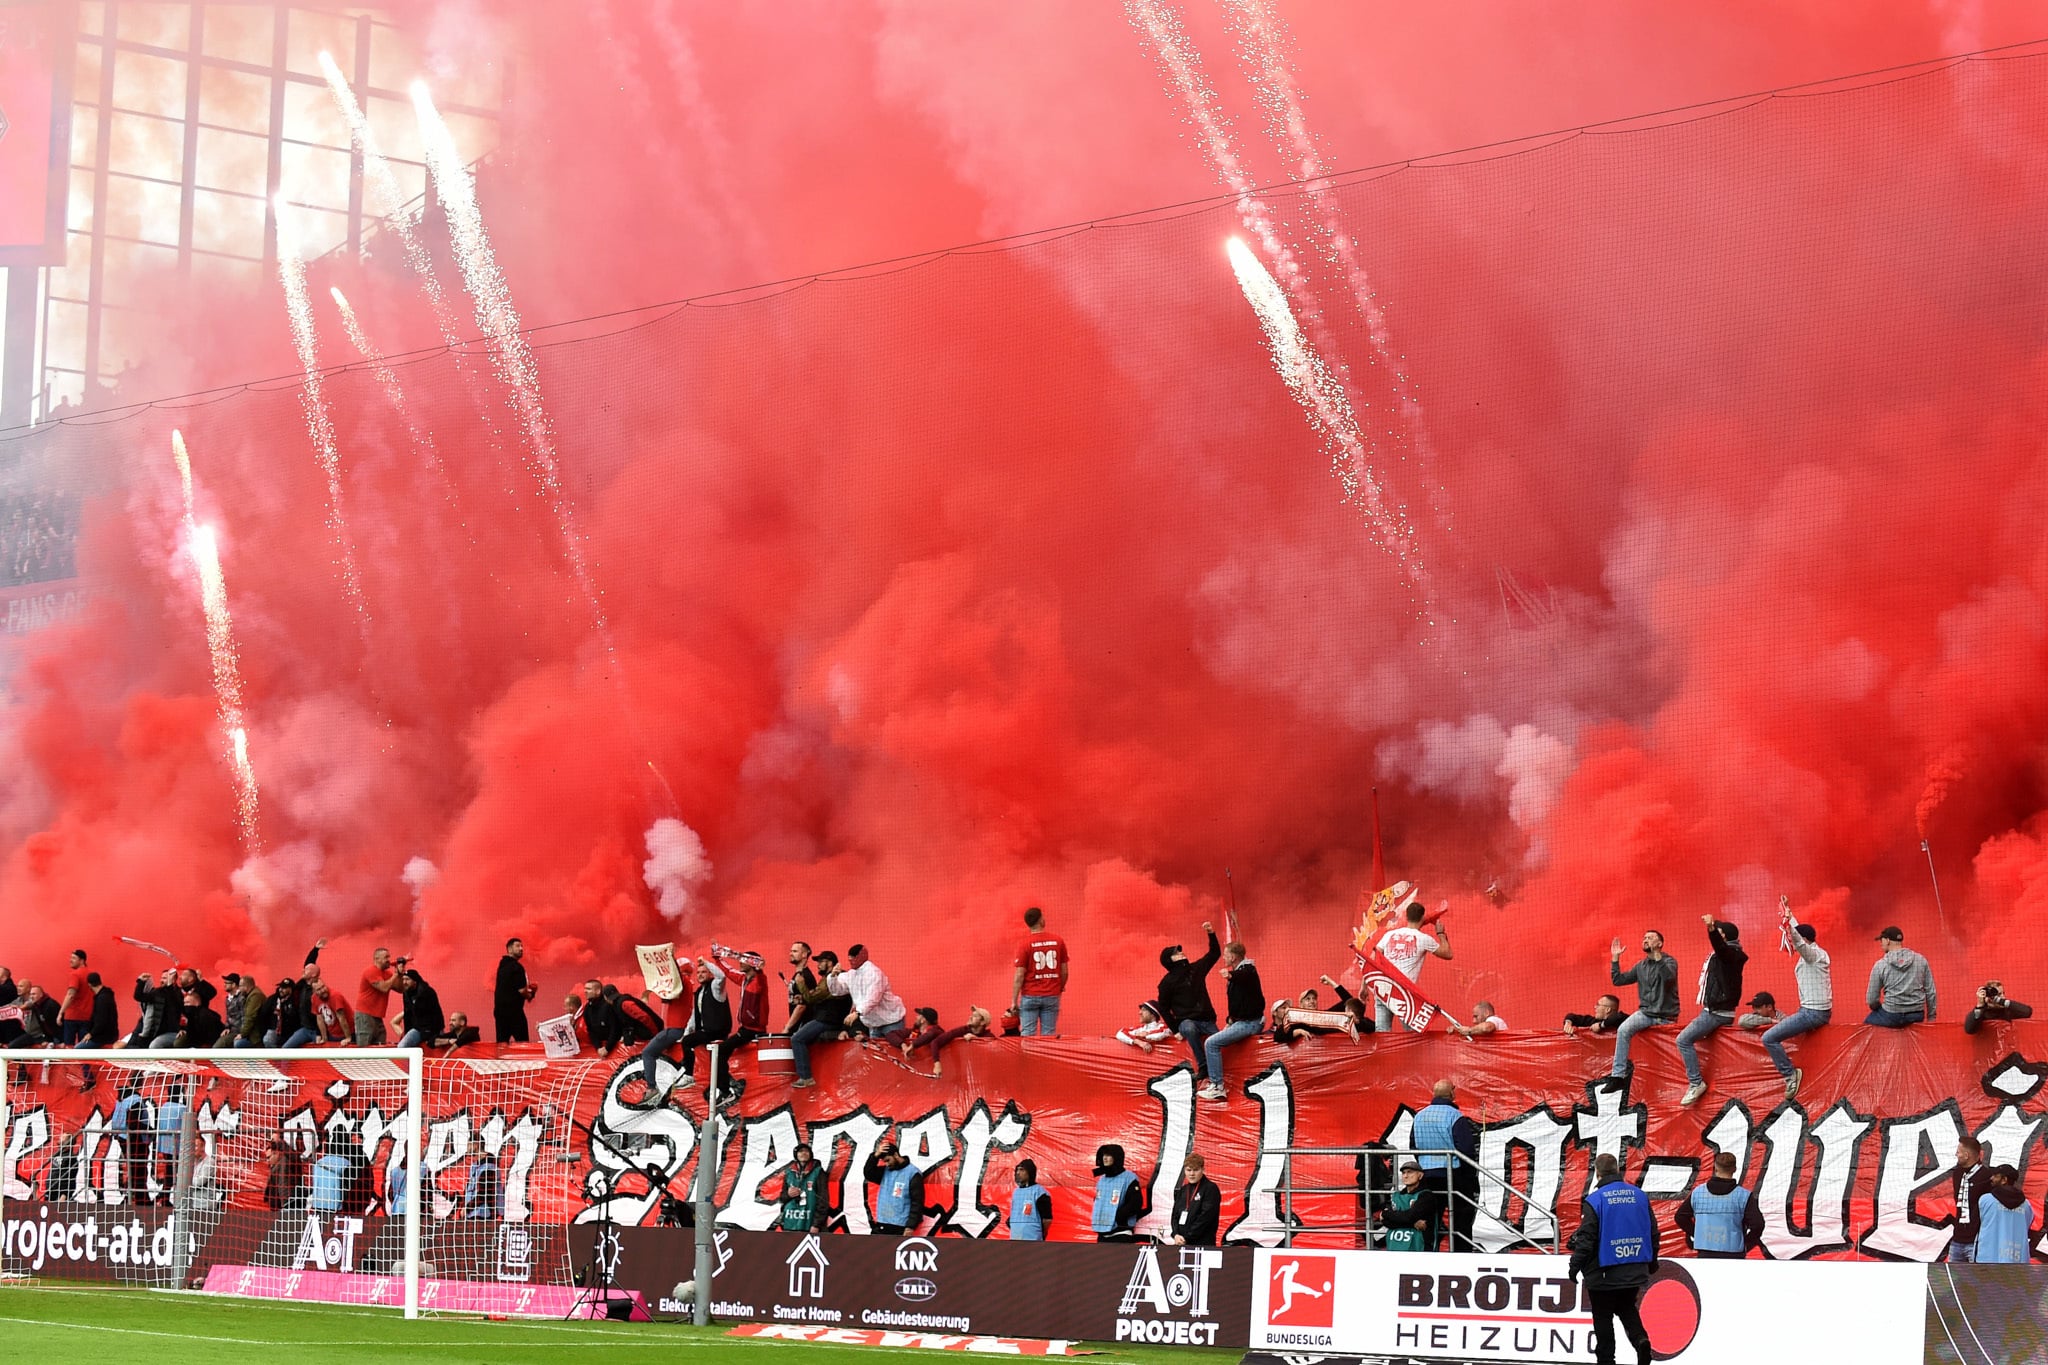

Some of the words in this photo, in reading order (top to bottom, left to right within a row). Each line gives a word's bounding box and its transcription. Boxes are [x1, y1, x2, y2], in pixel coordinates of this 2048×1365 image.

[1033, 950, 1057, 970] 96
[1602, 1189, 1636, 1198] SECURITY
[1607, 1197, 1637, 1205] SERVICE
[0, 1205, 196, 1271] roject-at.d
[1615, 1245, 1642, 1258] S047
[895, 1249, 938, 1272] KNX
[902, 1284, 930, 1295] DALI
[773, 1304, 808, 1320] Smart
[809, 1306, 842, 1322] Home
[861, 1308, 971, 1333] Gebäudesteuerung
[1115, 1318, 1220, 1346] PROJECT
[1266, 1332, 1333, 1347] BUNDESLIGA
